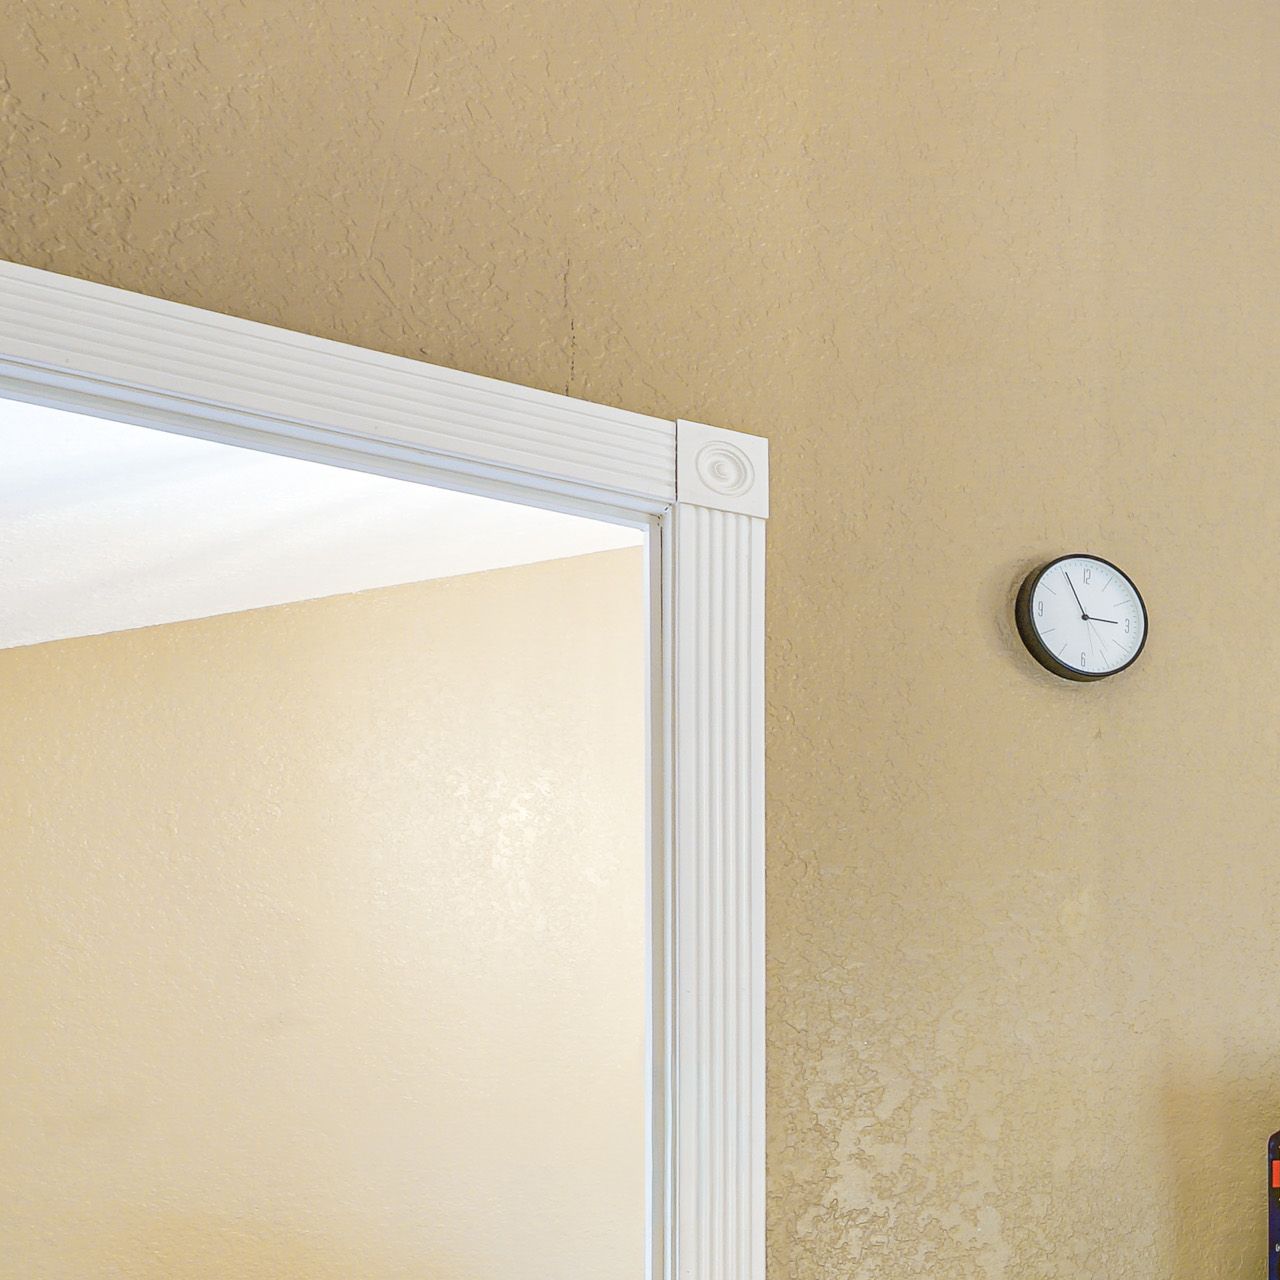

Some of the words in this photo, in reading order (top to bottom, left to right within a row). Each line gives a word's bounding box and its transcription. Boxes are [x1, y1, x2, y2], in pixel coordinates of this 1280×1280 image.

[1082, 568, 1092, 585] 12
[1037, 600, 1044, 617] 9
[1124, 618, 1131, 634] 3
[1080, 651, 1086, 668] 6
